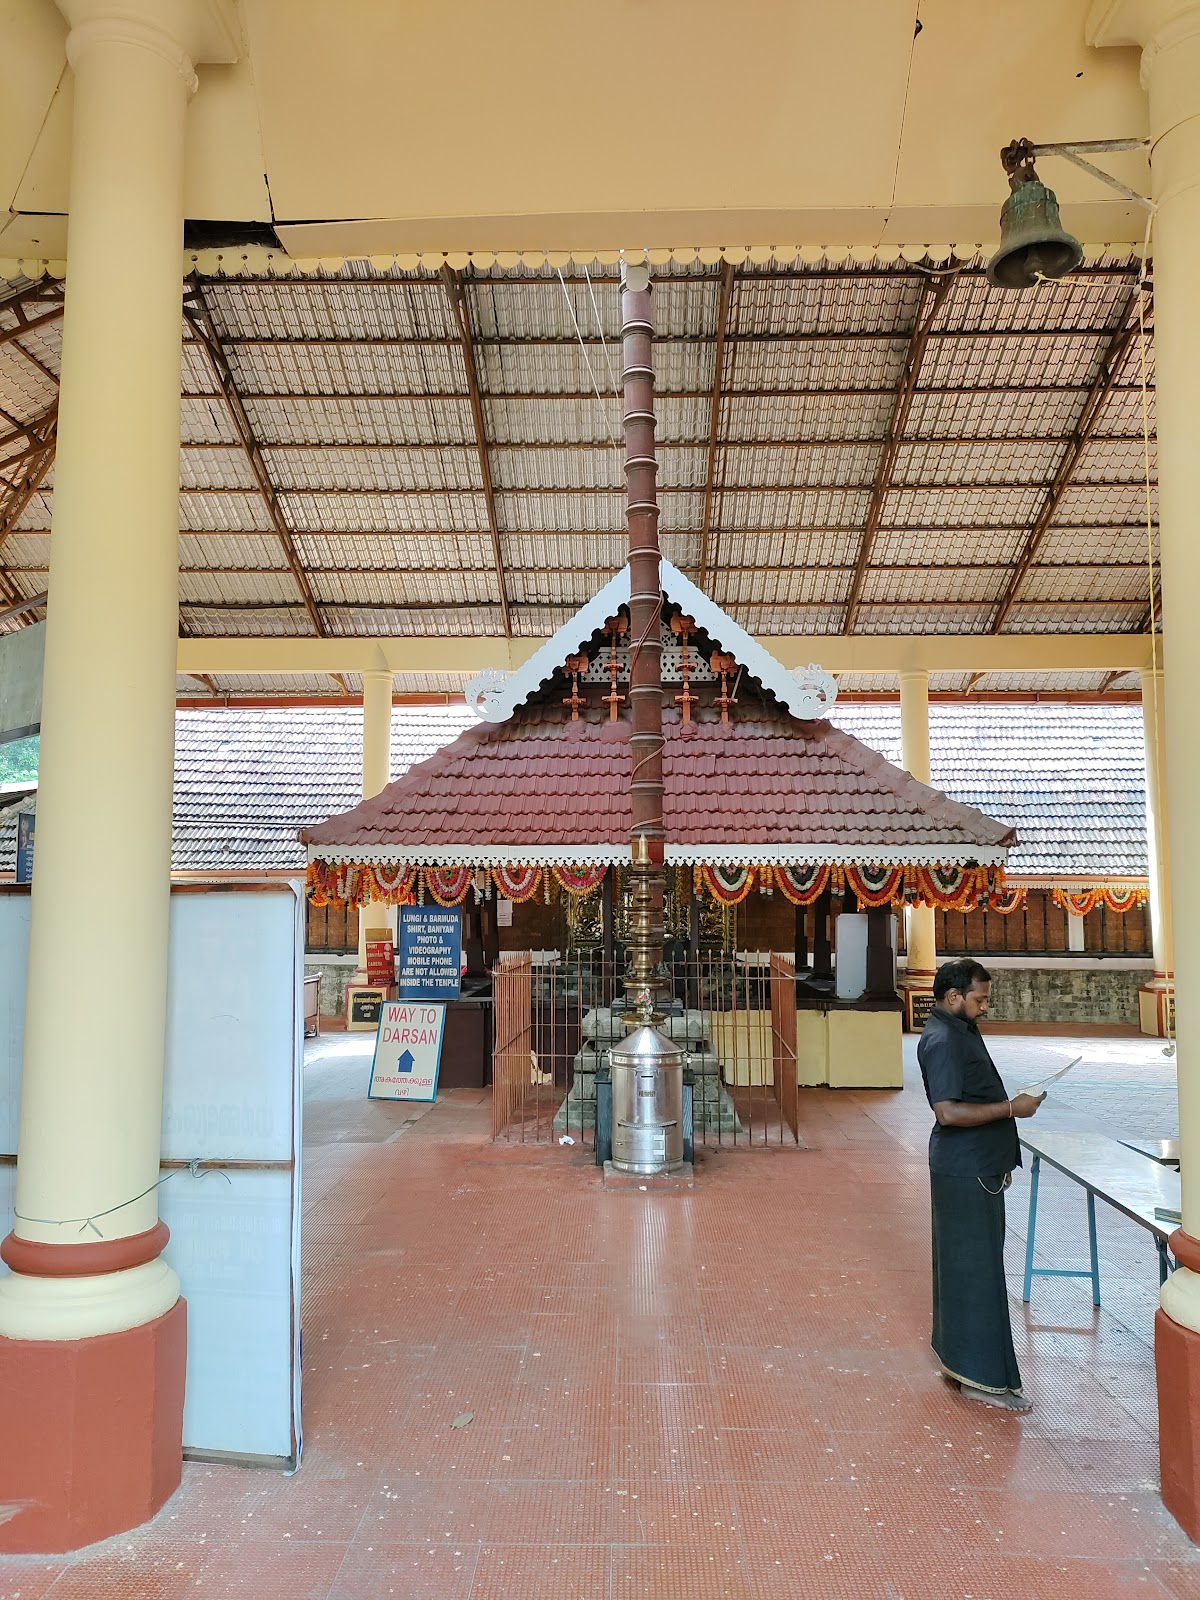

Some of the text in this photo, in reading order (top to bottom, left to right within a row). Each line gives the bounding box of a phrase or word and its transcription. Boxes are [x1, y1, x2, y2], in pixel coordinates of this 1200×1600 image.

[403, 914, 459, 923] LUNGI & BARMUDA
[407, 925, 454, 934] SHIRT, BANIYAN
[417, 936, 443, 944] PHOTO &
[408, 946, 452, 954] VIDEOGRAPHY
[407, 957, 453, 965] MOBILE PHONE
[401, 968, 458, 976] ARE NOT ALLOWED
[400, 978, 421, 987] INSIDE
[421, 978, 434, 987] THE
[434, 978, 459, 987] TEMPLE
[388, 1007, 416, 1023] WAY
[420, 1008, 436, 1024] TO
[382, 1027, 438, 1045] DARSAN
